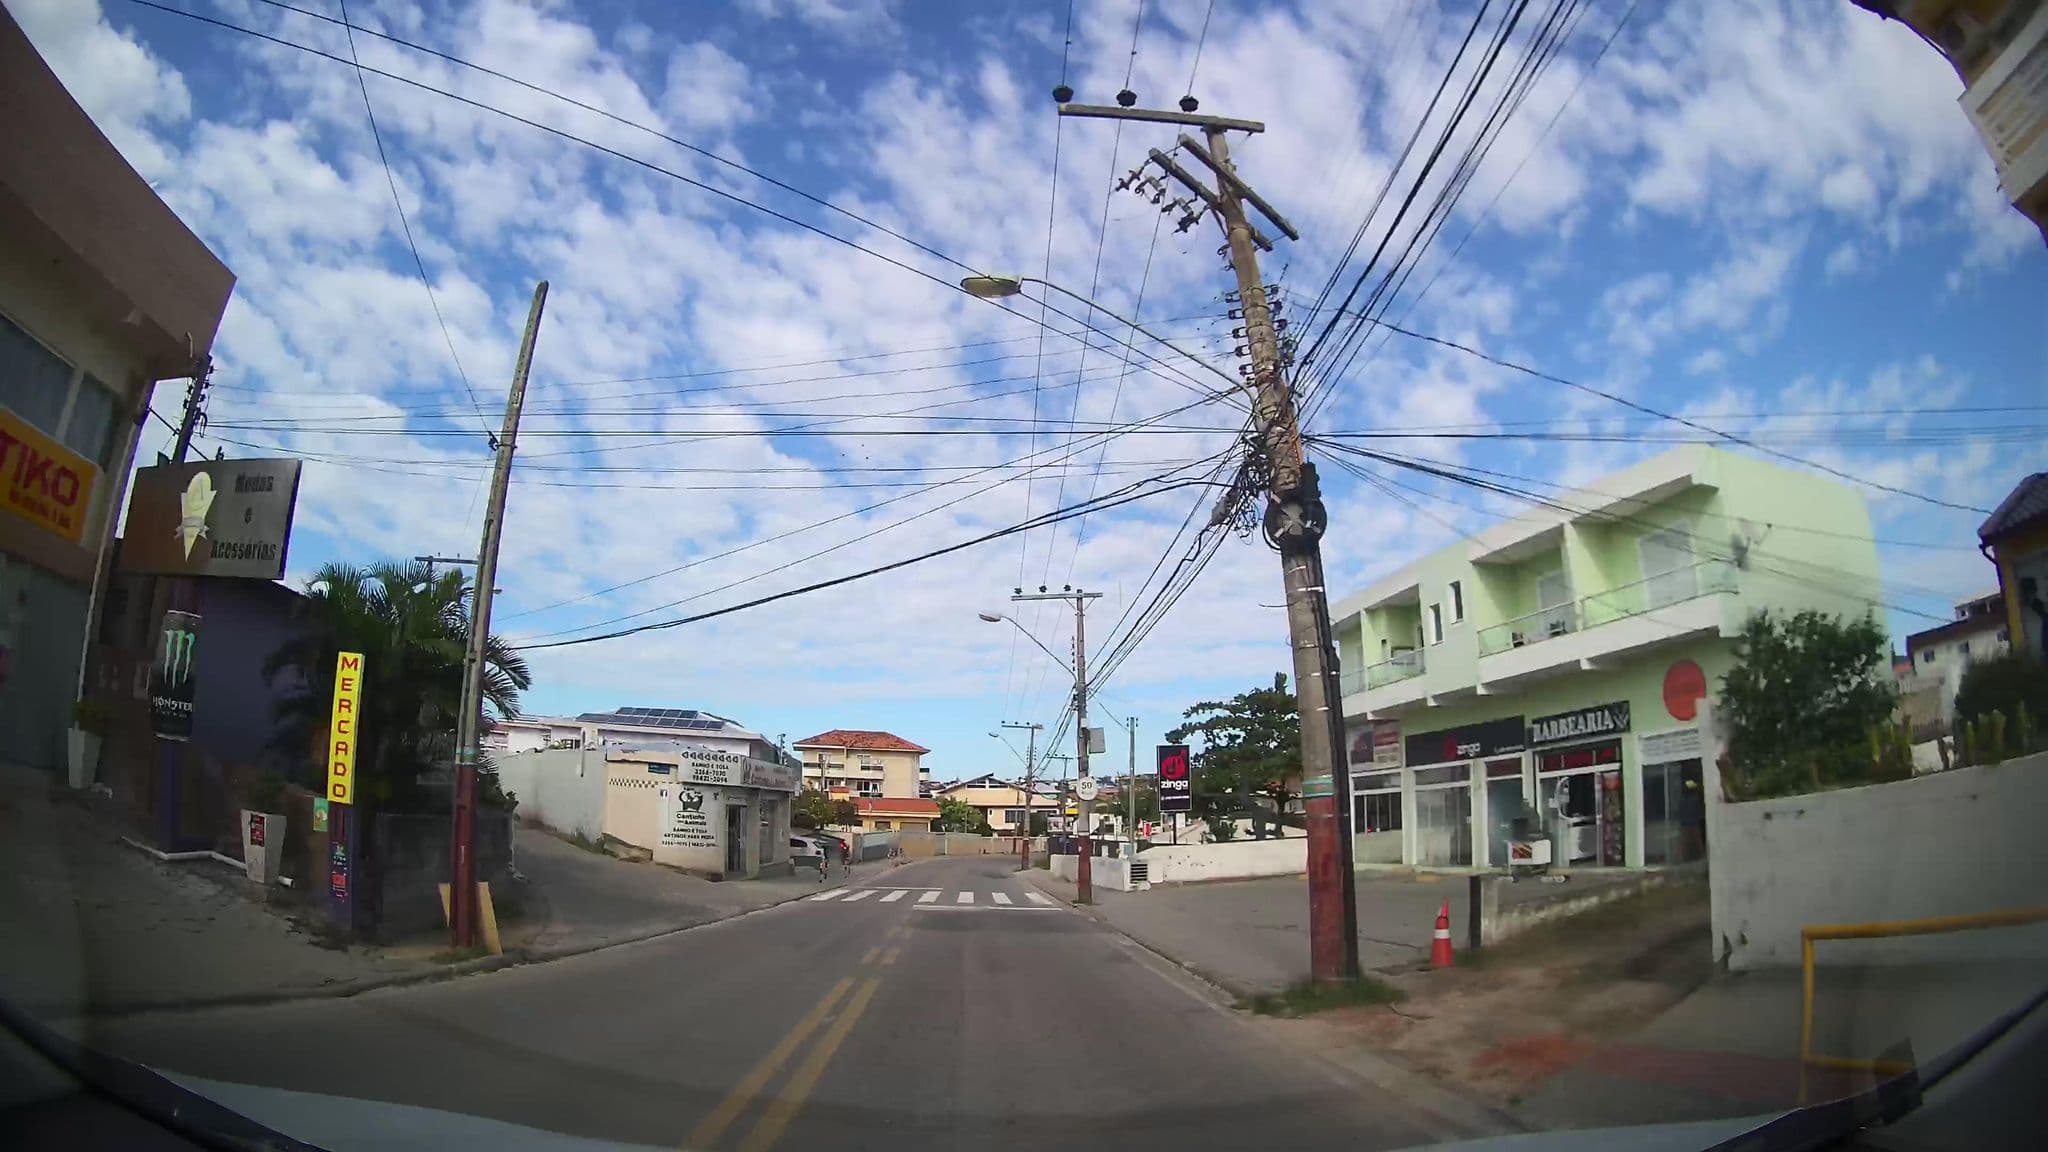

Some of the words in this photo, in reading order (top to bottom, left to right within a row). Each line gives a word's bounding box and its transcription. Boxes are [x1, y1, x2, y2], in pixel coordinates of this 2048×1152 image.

[332, 656, 359, 798] MERCADO
[1533, 709, 1614, 742] BARBEARIA
[1081, 781, 1093, 790] 50
[1160, 779, 1189, 790] zinga
